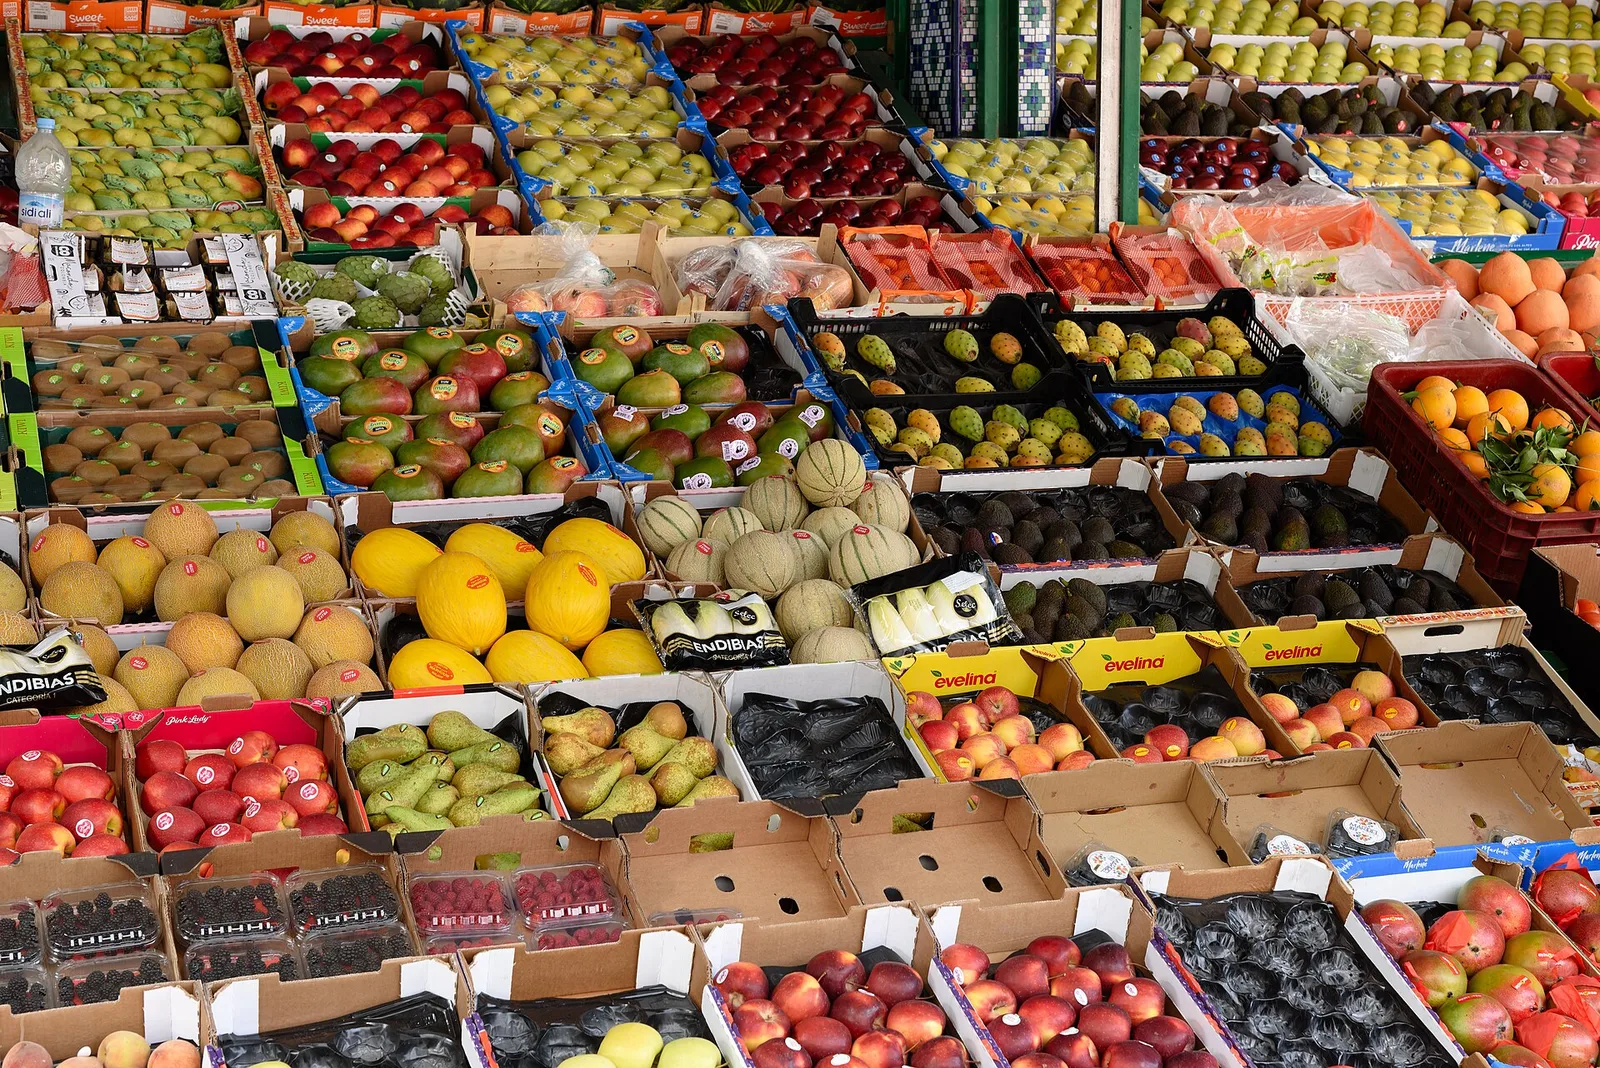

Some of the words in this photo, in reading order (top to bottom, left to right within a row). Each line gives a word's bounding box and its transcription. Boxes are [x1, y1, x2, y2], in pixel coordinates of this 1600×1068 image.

[69, 13, 104, 23] Sweet
[306, 15, 340, 25] Sweet
[528, 23, 561, 32] Sweet
[746, 21, 775, 30] Swet
[843, 22, 871, 31] Sweet
[21, 207, 37, 217] sidi
[38, 208, 52, 218] ali
[1451, 237, 1496, 253] Marlene
[4, 333, 15, 349] KIWI
[277, 381, 290, 396] KIWI
[16, 419, 28, 435] KIWI
[303, 472, 316, 488] KIWI
[692, 634, 764, 654] ENDIBIAS
[1198, 633, 1223, 646] evelina
[1264, 644, 1322, 661] evelina
[1104, 655, 1164, 673] evelina
[934, 671, 997, 689] evelina
[165, 715, 187, 725] Pink
[188, 714, 209, 724] Lady
[1403, 858, 1428, 872] Marlene
